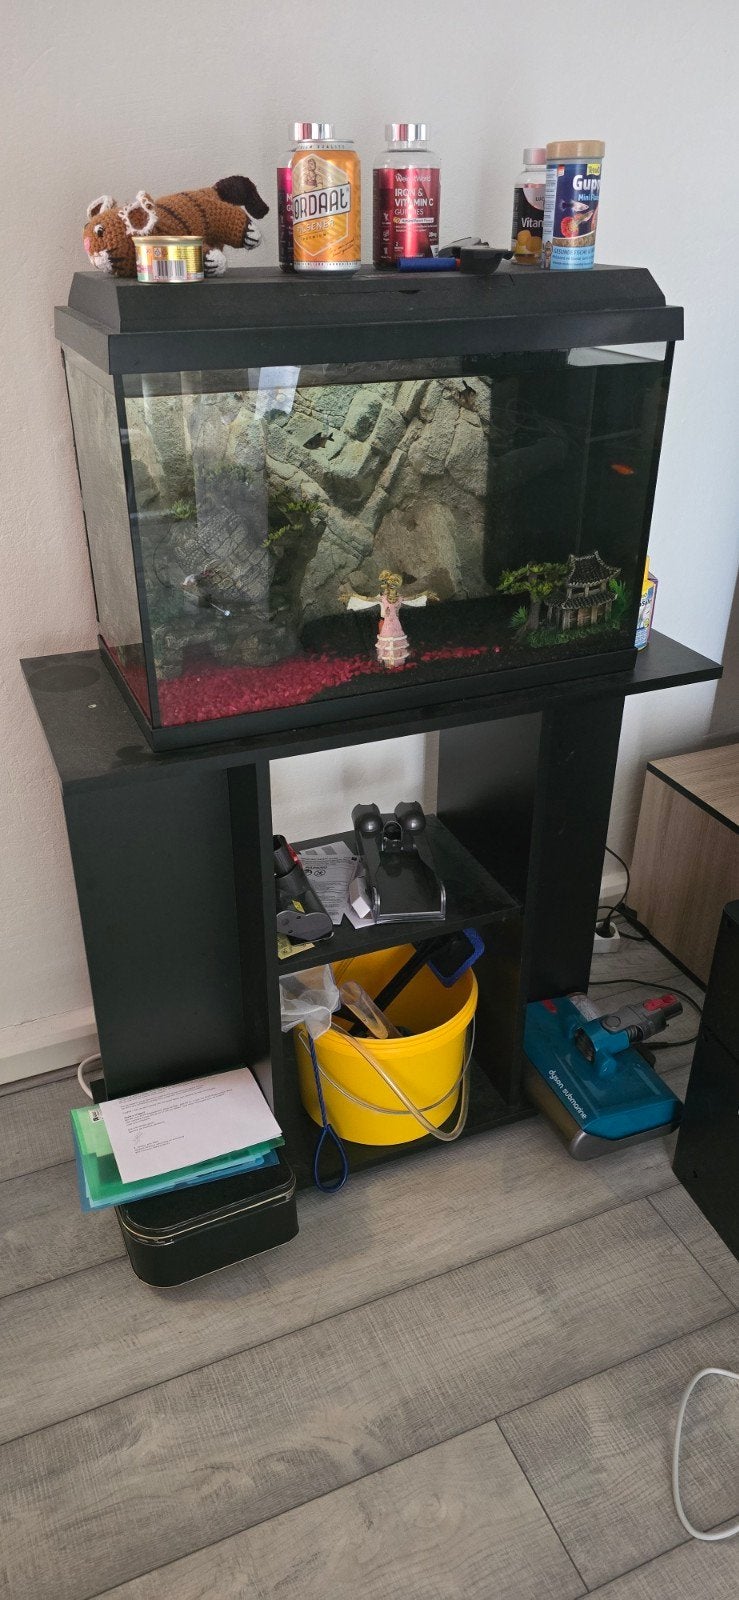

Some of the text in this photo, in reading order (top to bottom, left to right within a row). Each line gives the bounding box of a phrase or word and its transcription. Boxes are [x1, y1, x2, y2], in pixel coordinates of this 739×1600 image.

[394, 188, 424, 197] IRON &
[394, 198, 434, 207] VITAMIN C
[394, 208, 424, 216] GUES
[548, 1069, 588, 1120] dyson submarine
